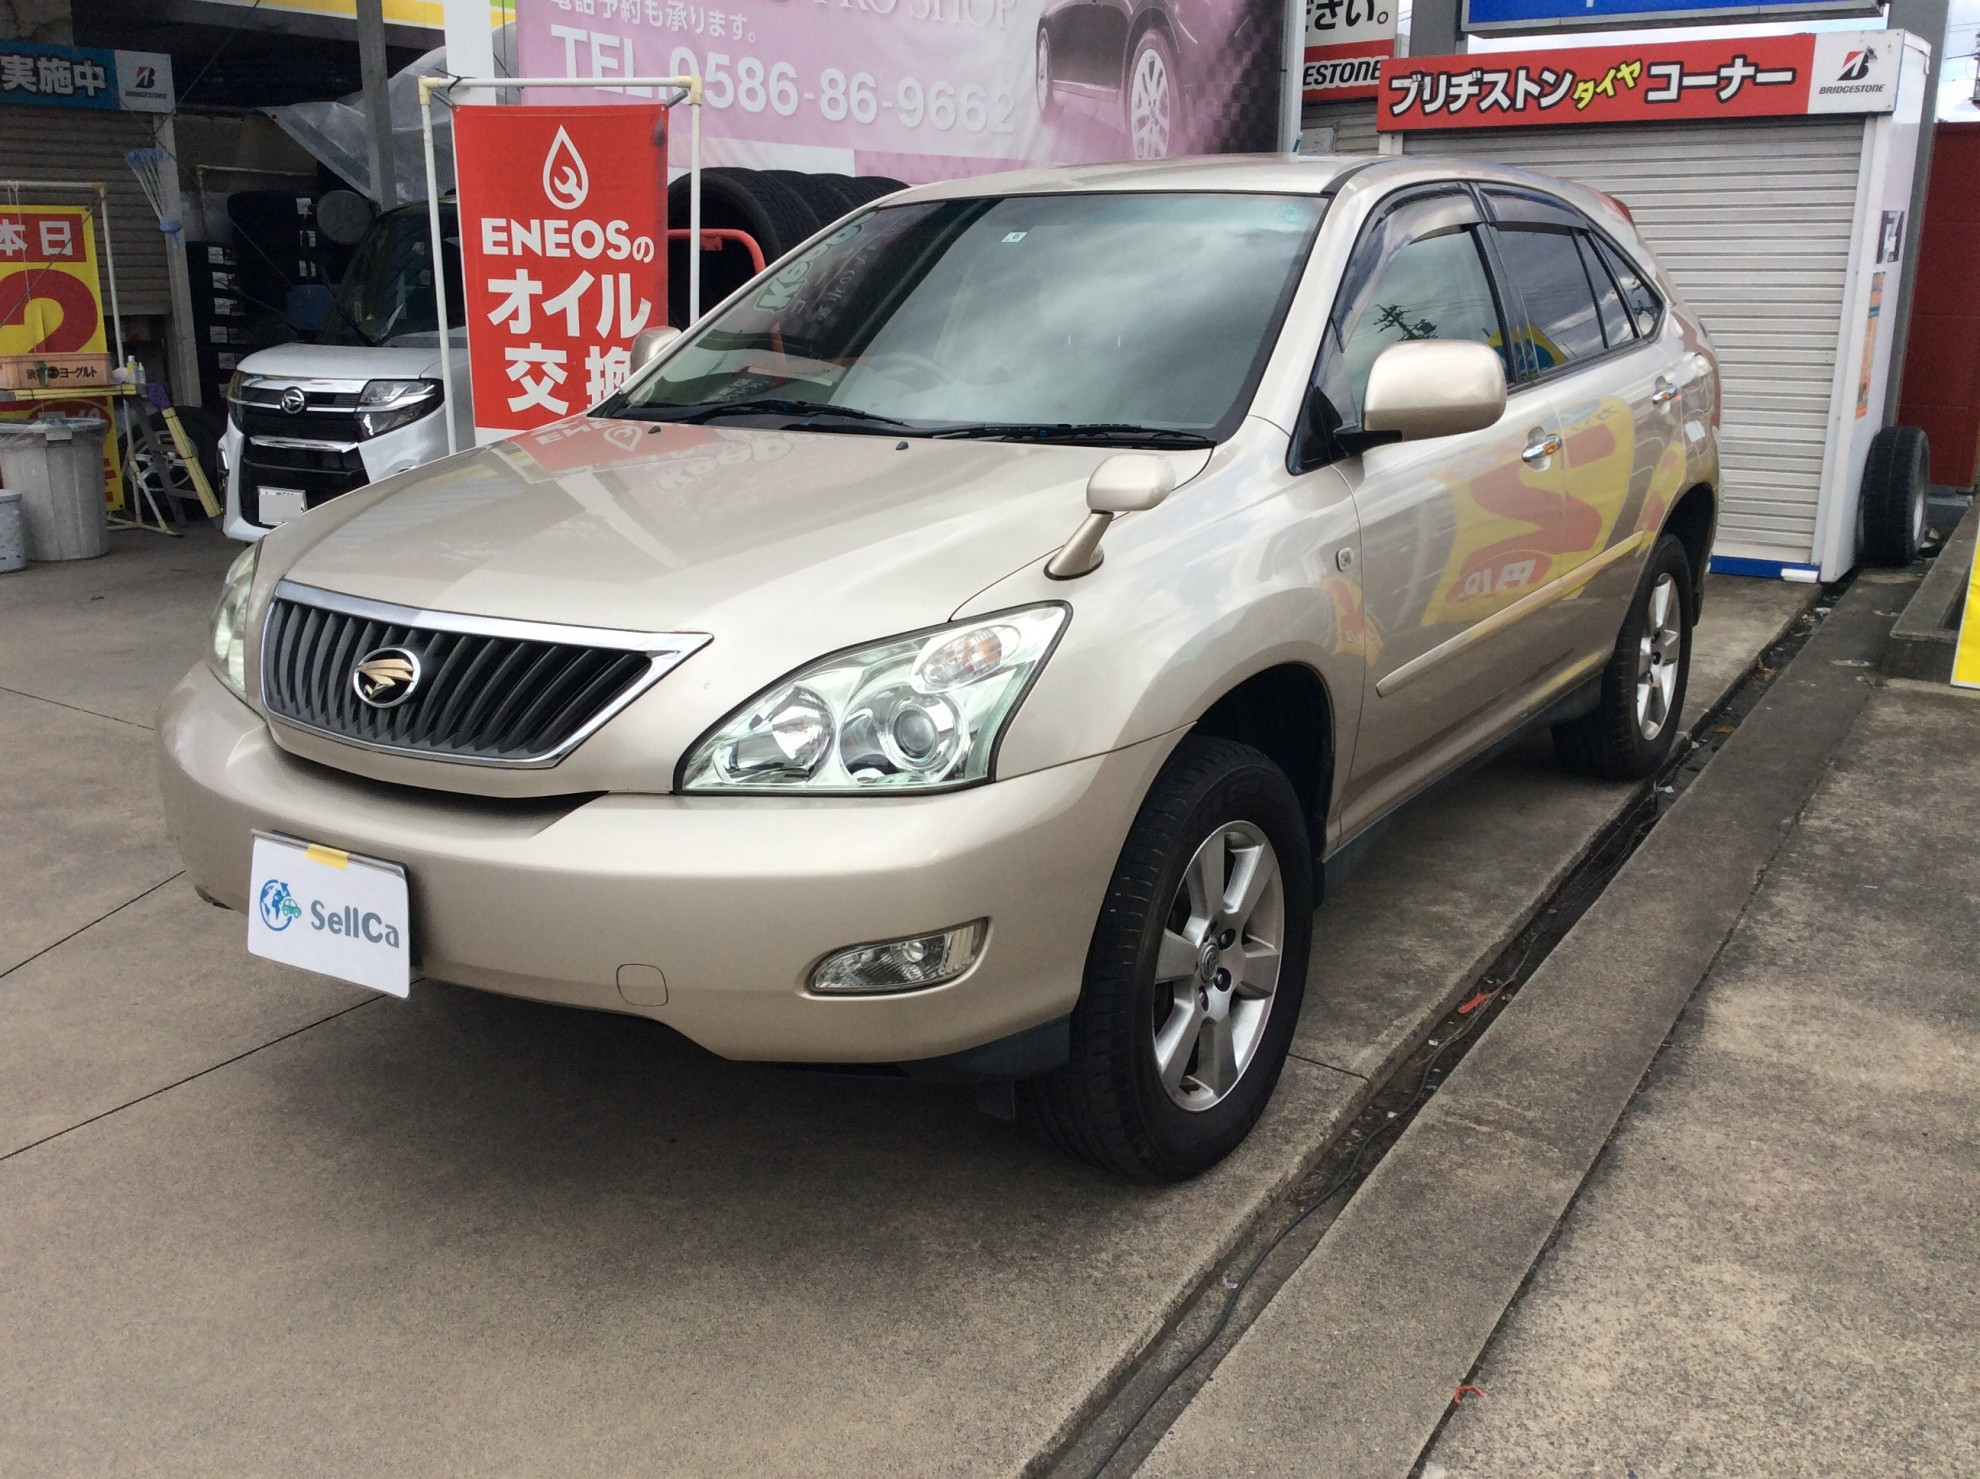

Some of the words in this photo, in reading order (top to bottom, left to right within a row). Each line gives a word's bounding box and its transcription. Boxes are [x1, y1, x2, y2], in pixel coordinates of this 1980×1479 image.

[1306, 0, 1389, 32] さい。
[1, 55, 106, 96] 実施中
[1818, 84, 1886, 95] BRIDGESTONE
[481, 217, 655, 263] ENEOSの
[487, 268, 652, 339] オイル
[310, 899, 400, 949] SellCa
